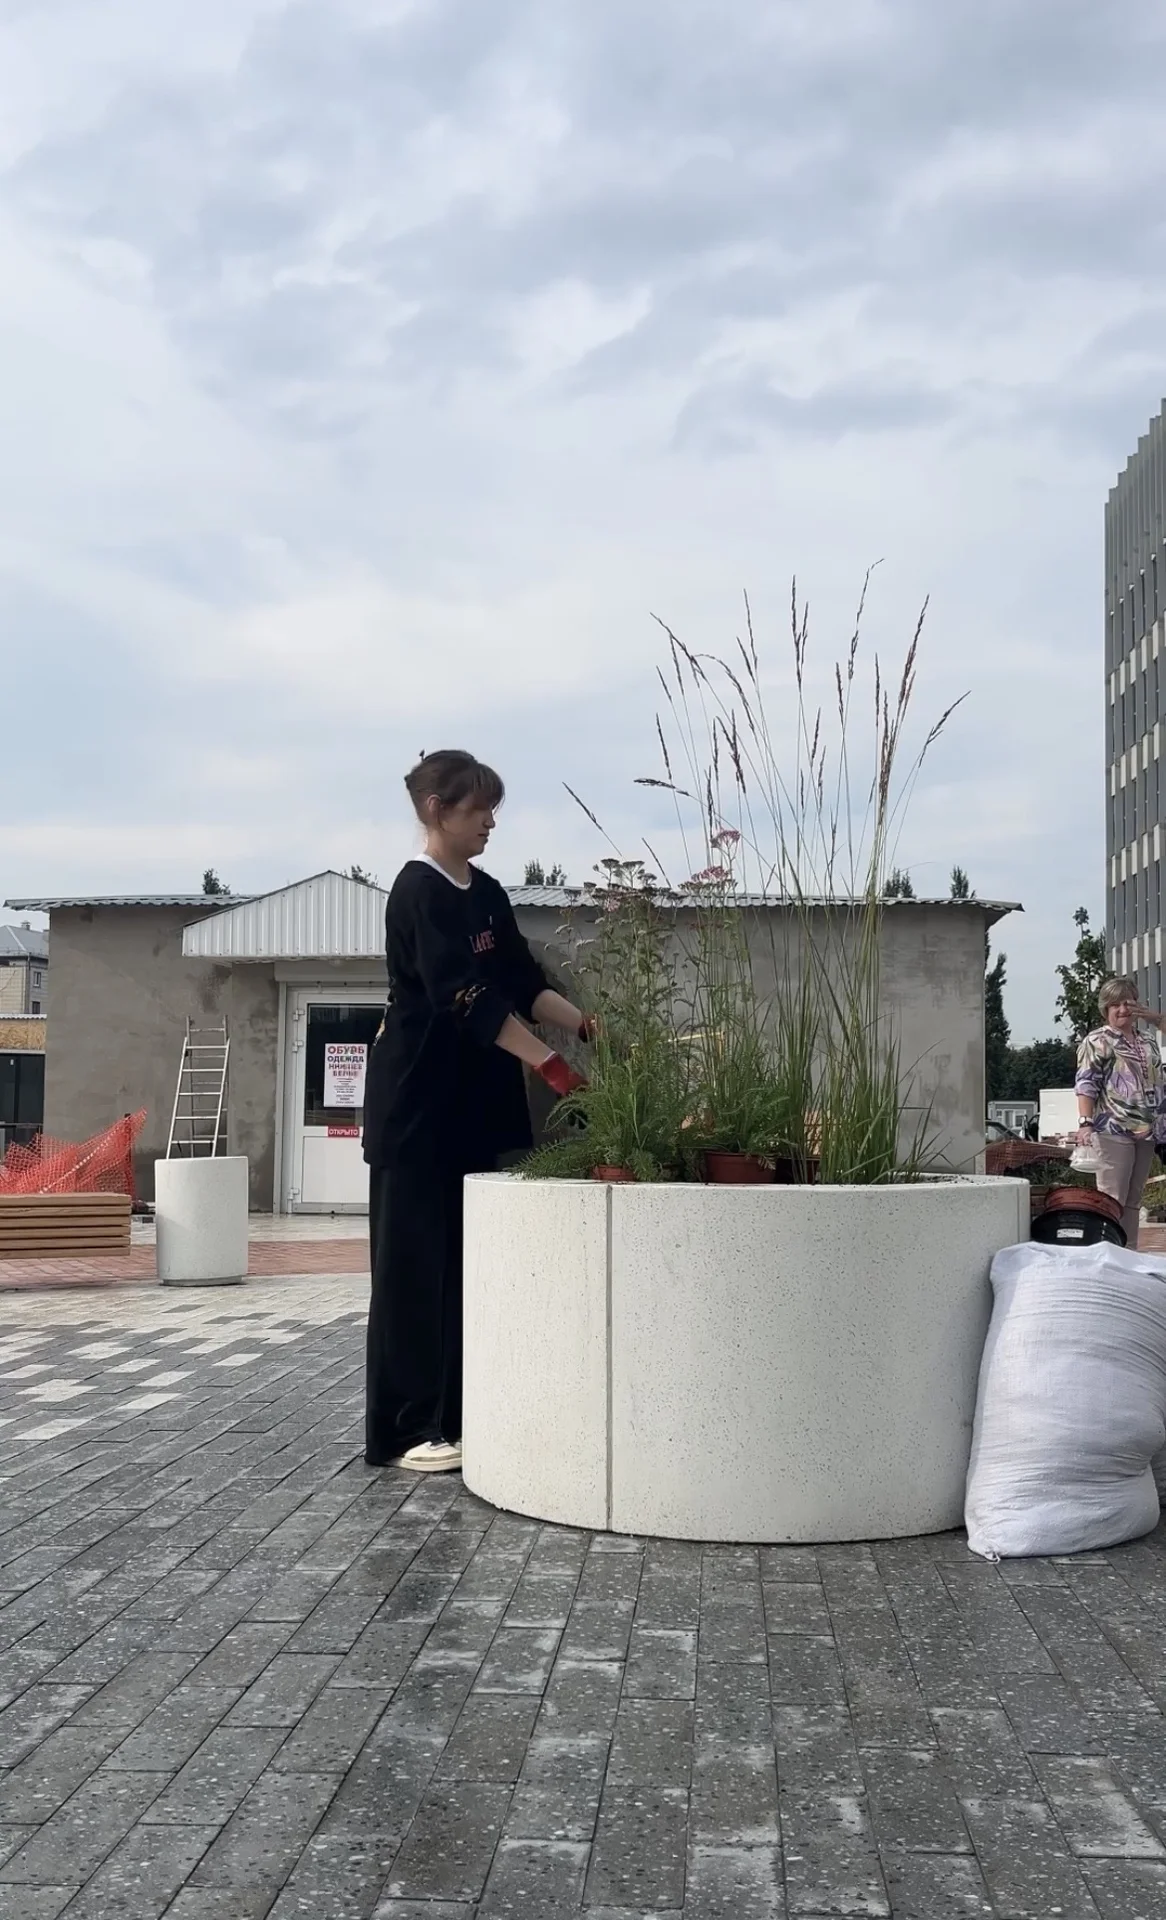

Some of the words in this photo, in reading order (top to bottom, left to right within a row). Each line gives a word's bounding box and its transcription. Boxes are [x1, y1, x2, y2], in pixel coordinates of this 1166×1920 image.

[327, 1046, 364, 1054] ОБУВЬ
[327, 1055, 364, 1063] ОДЕЖДА
[328, 1128, 359, 1136] ОТКРЫТО
